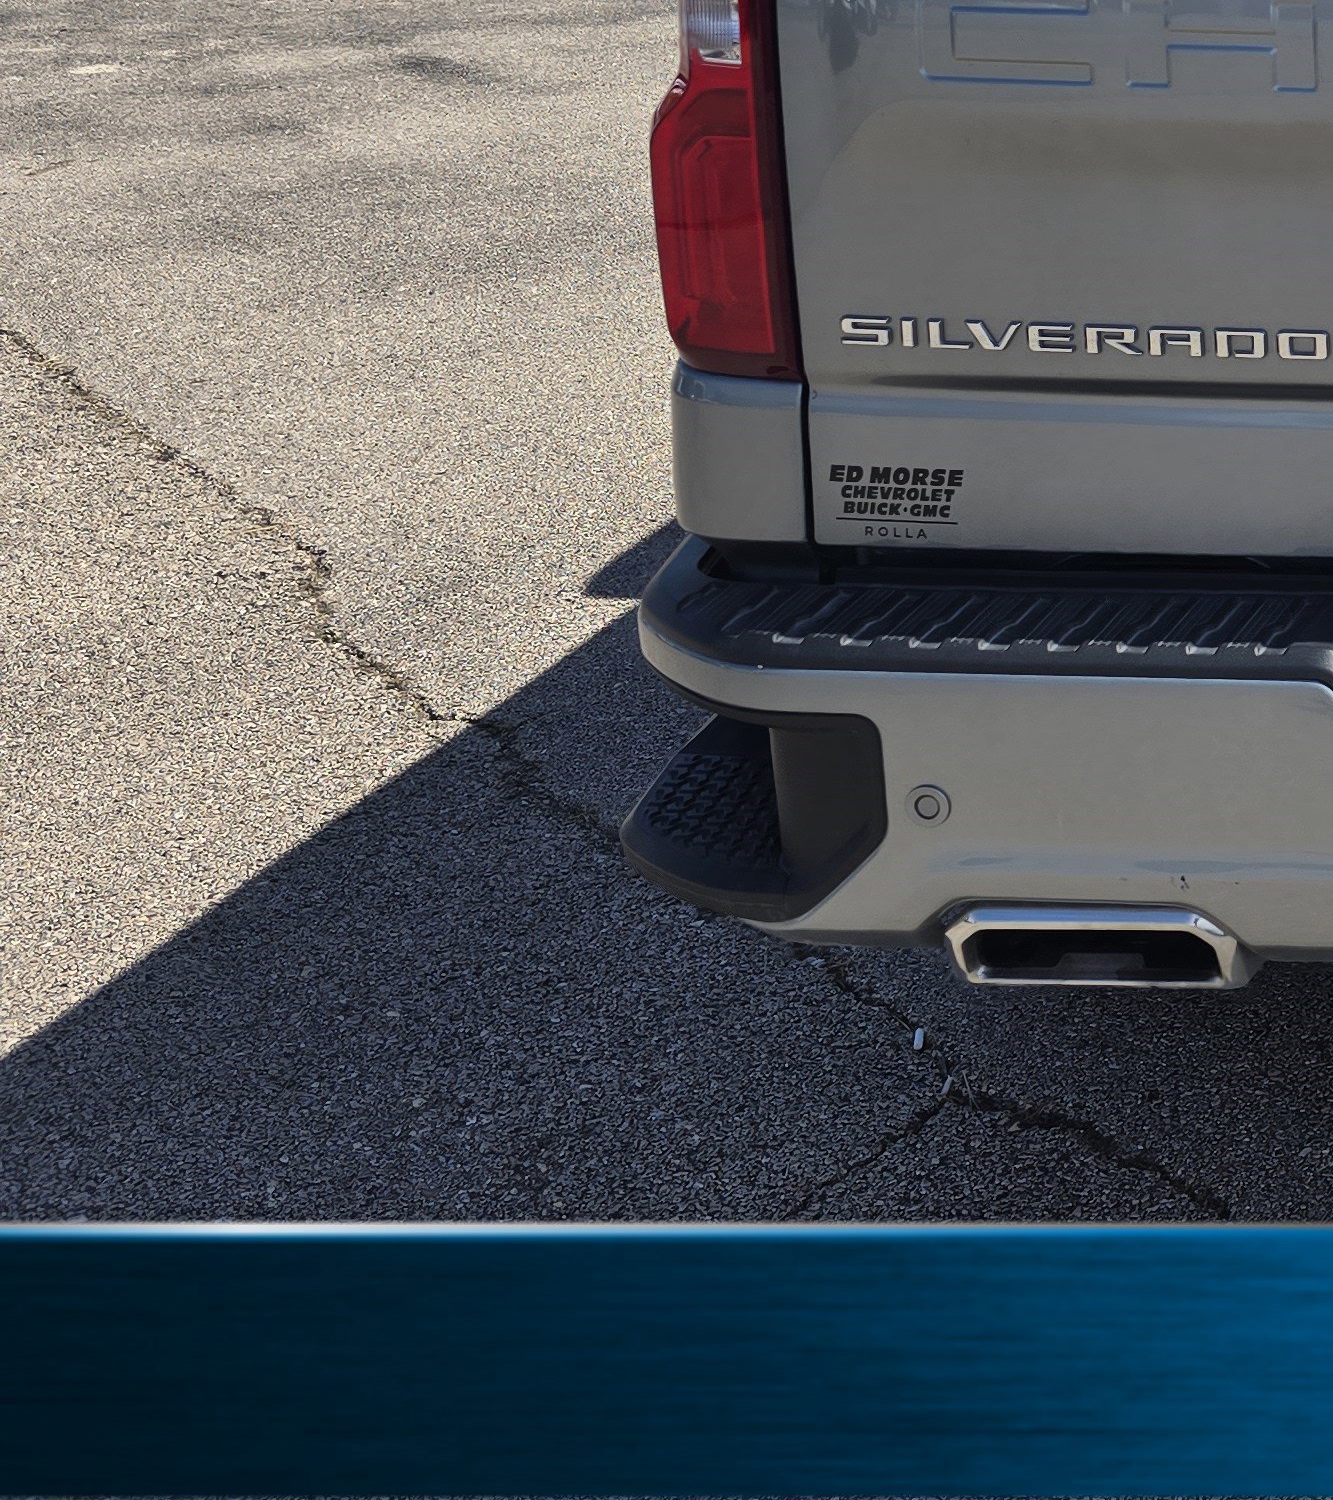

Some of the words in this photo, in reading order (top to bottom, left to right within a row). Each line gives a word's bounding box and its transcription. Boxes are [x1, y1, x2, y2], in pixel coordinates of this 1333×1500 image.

[839, 314, 1331, 361] SILVERADO
[828, 464, 864, 483] ED
[869, 465, 965, 487] MORSE
[840, 484, 956, 502] CHEVROLET
[864, 525, 928, 540] ROLLA
